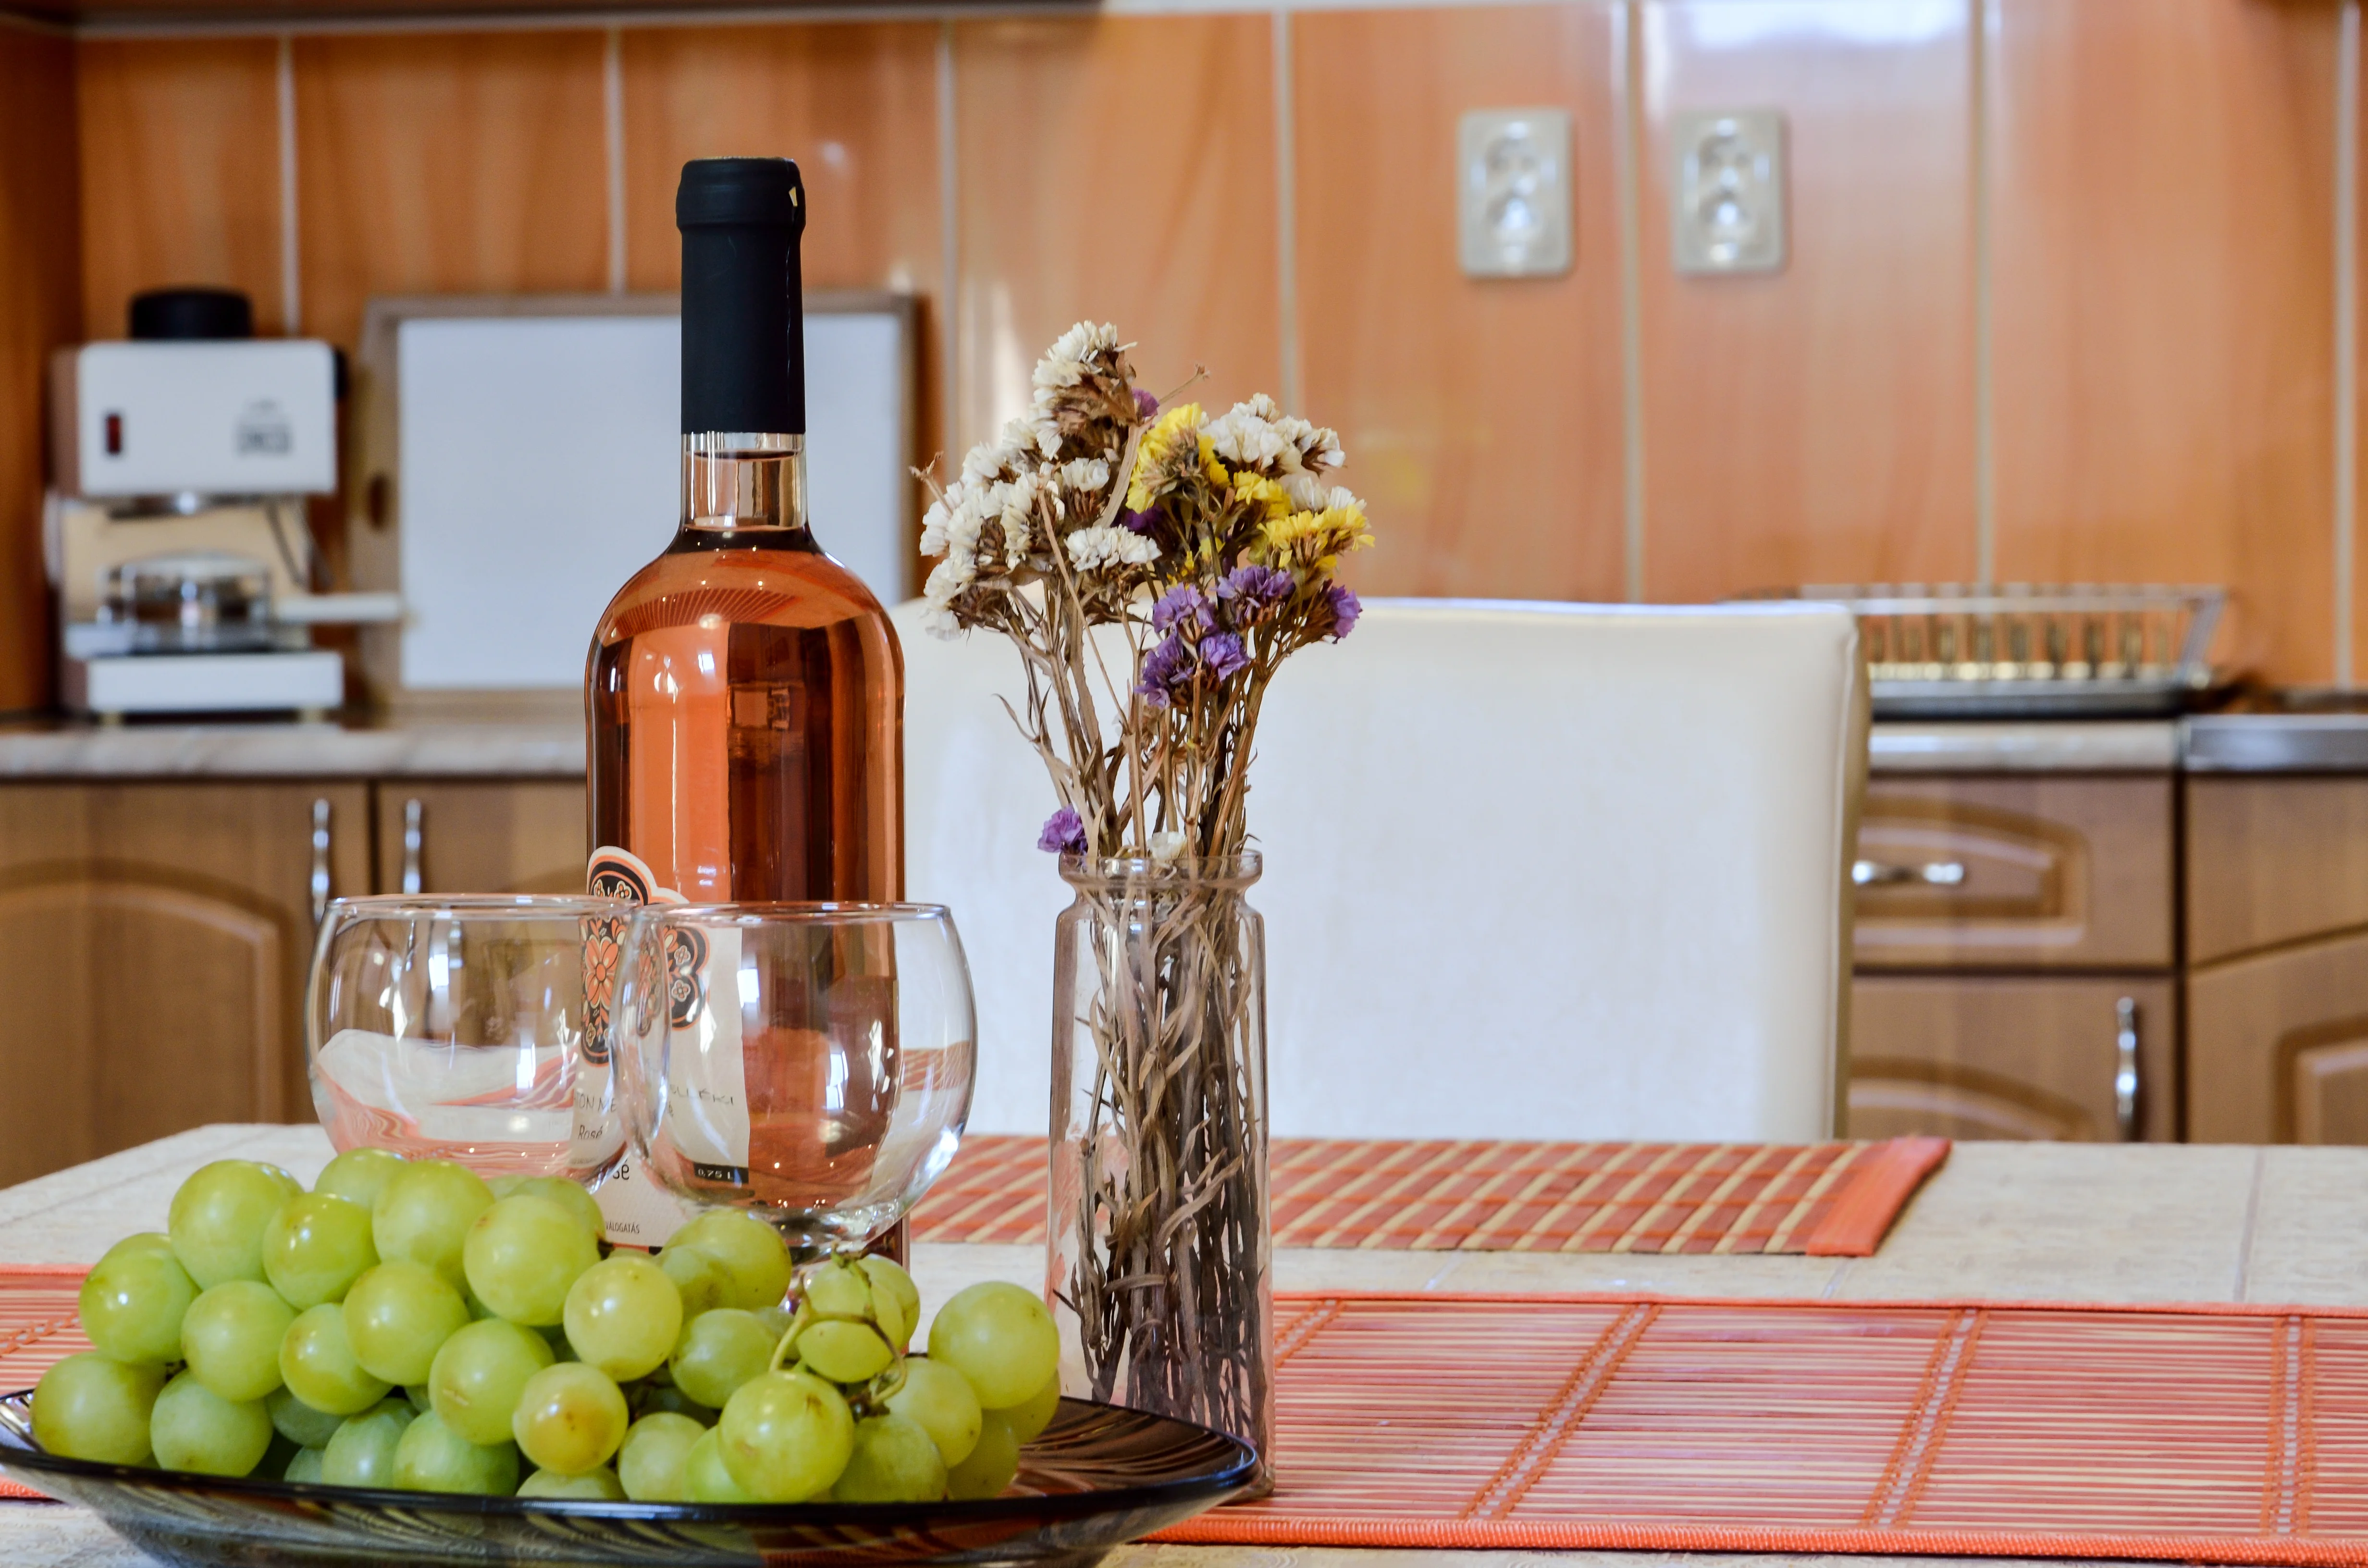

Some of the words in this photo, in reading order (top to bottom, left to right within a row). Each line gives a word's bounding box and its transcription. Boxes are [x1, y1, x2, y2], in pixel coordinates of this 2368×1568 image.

[578, 1125, 603, 1140] Rosé
[698, 1168, 722, 1179] 0,75
[605, 1219, 641, 1234] VÁLOGATÁS
